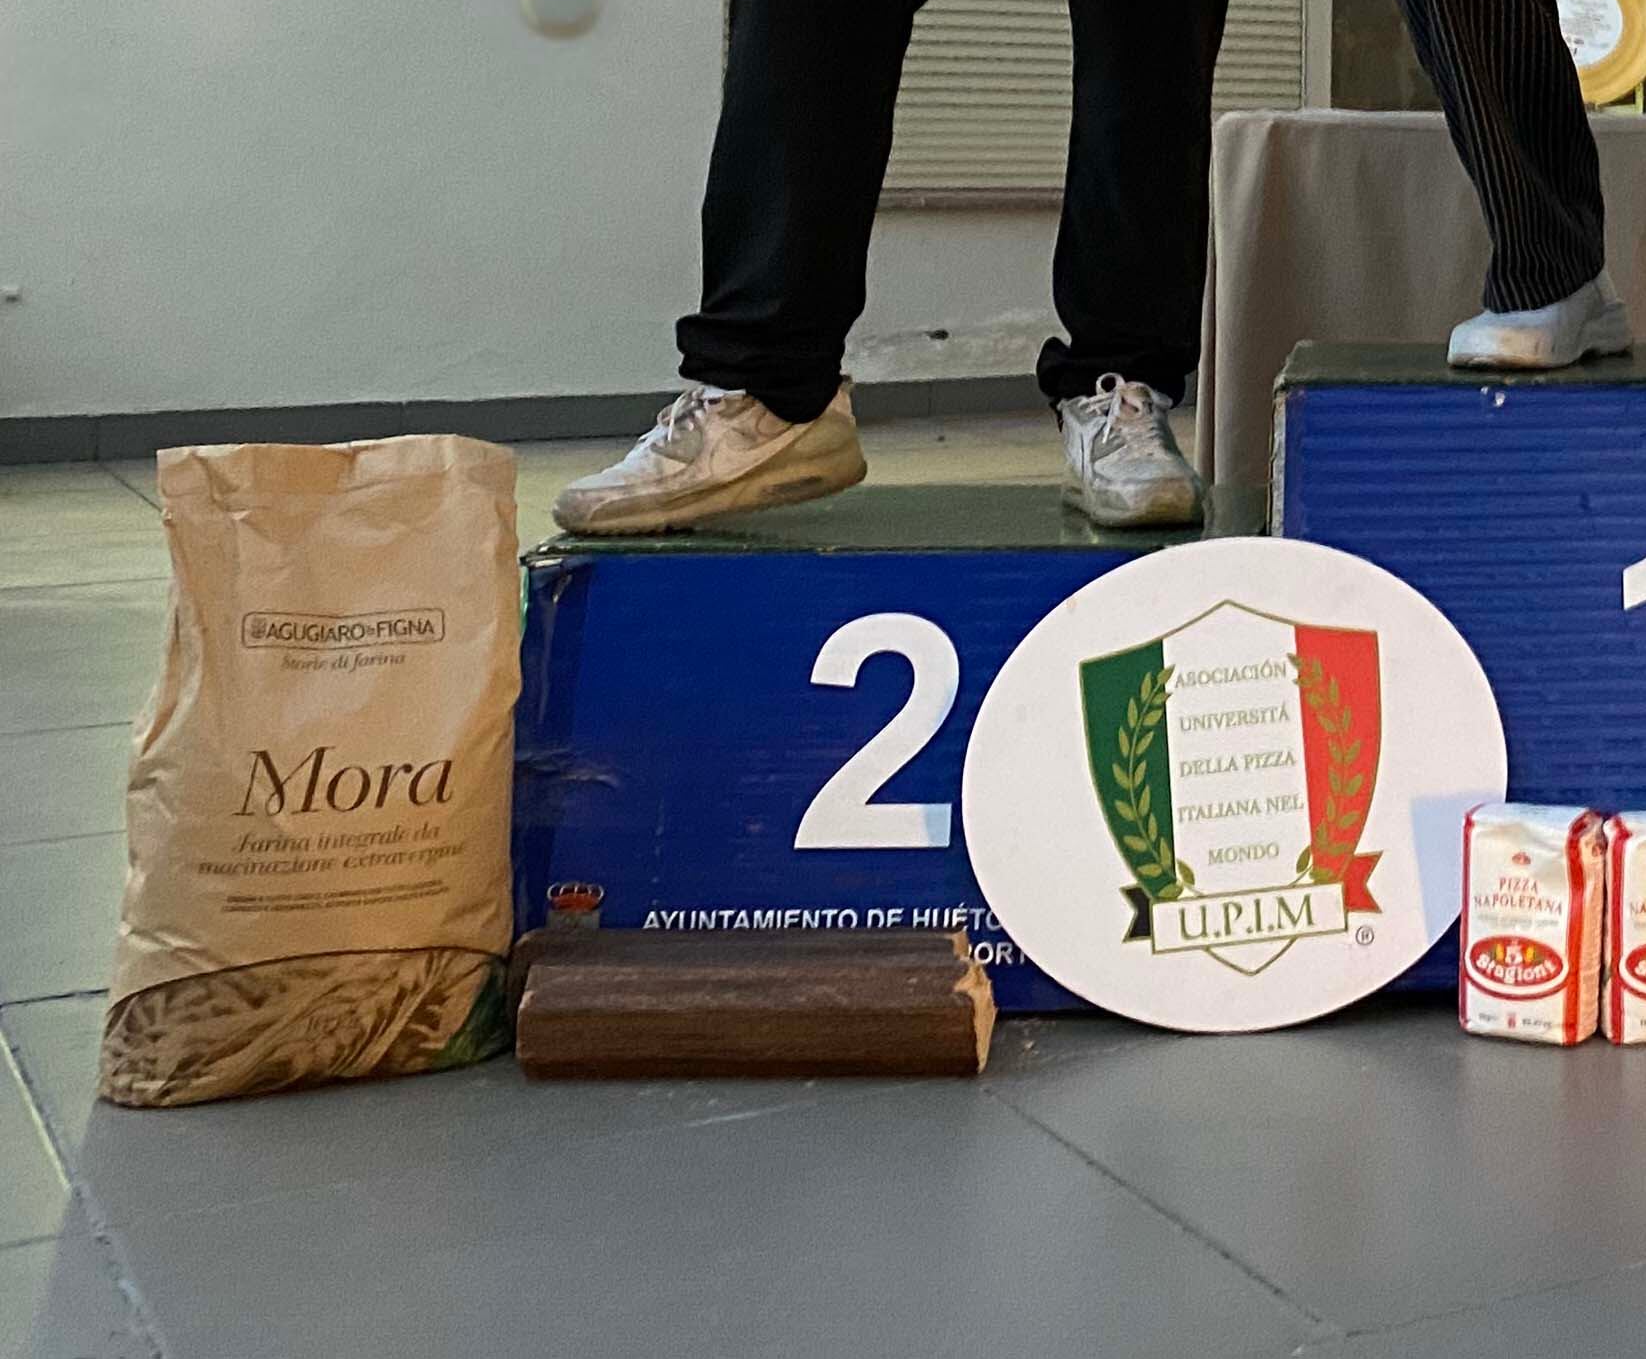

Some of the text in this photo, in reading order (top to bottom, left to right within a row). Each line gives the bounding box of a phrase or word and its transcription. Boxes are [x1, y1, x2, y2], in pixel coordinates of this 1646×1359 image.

[266, 621, 366, 643] AGUGIARO
[376, 617, 436, 639] FIGNA
[331, 652, 349, 670] di
[351, 652, 407, 674] farina
[1174, 658, 1288, 690] ASOCIACIÓN
[794, 611, 961, 851] 2
[1178, 748, 1298, 780] DELLA PIZZA
[231, 744, 455, 818] Mora
[1176, 793, 1305, 825] ITALIANA NEL
[316, 824, 409, 851] integrale
[413, 821, 441, 842] da
[196, 843, 466, 877] macinazione extravergine
[1207, 841, 1281, 868] MONDO
[1497, 876, 1539, 894] PIZZA
[642, 901, 1003, 932] AYUNTAMIENTO DE HUÉTO
[1472, 894, 1564, 917] NAPOLETANA
